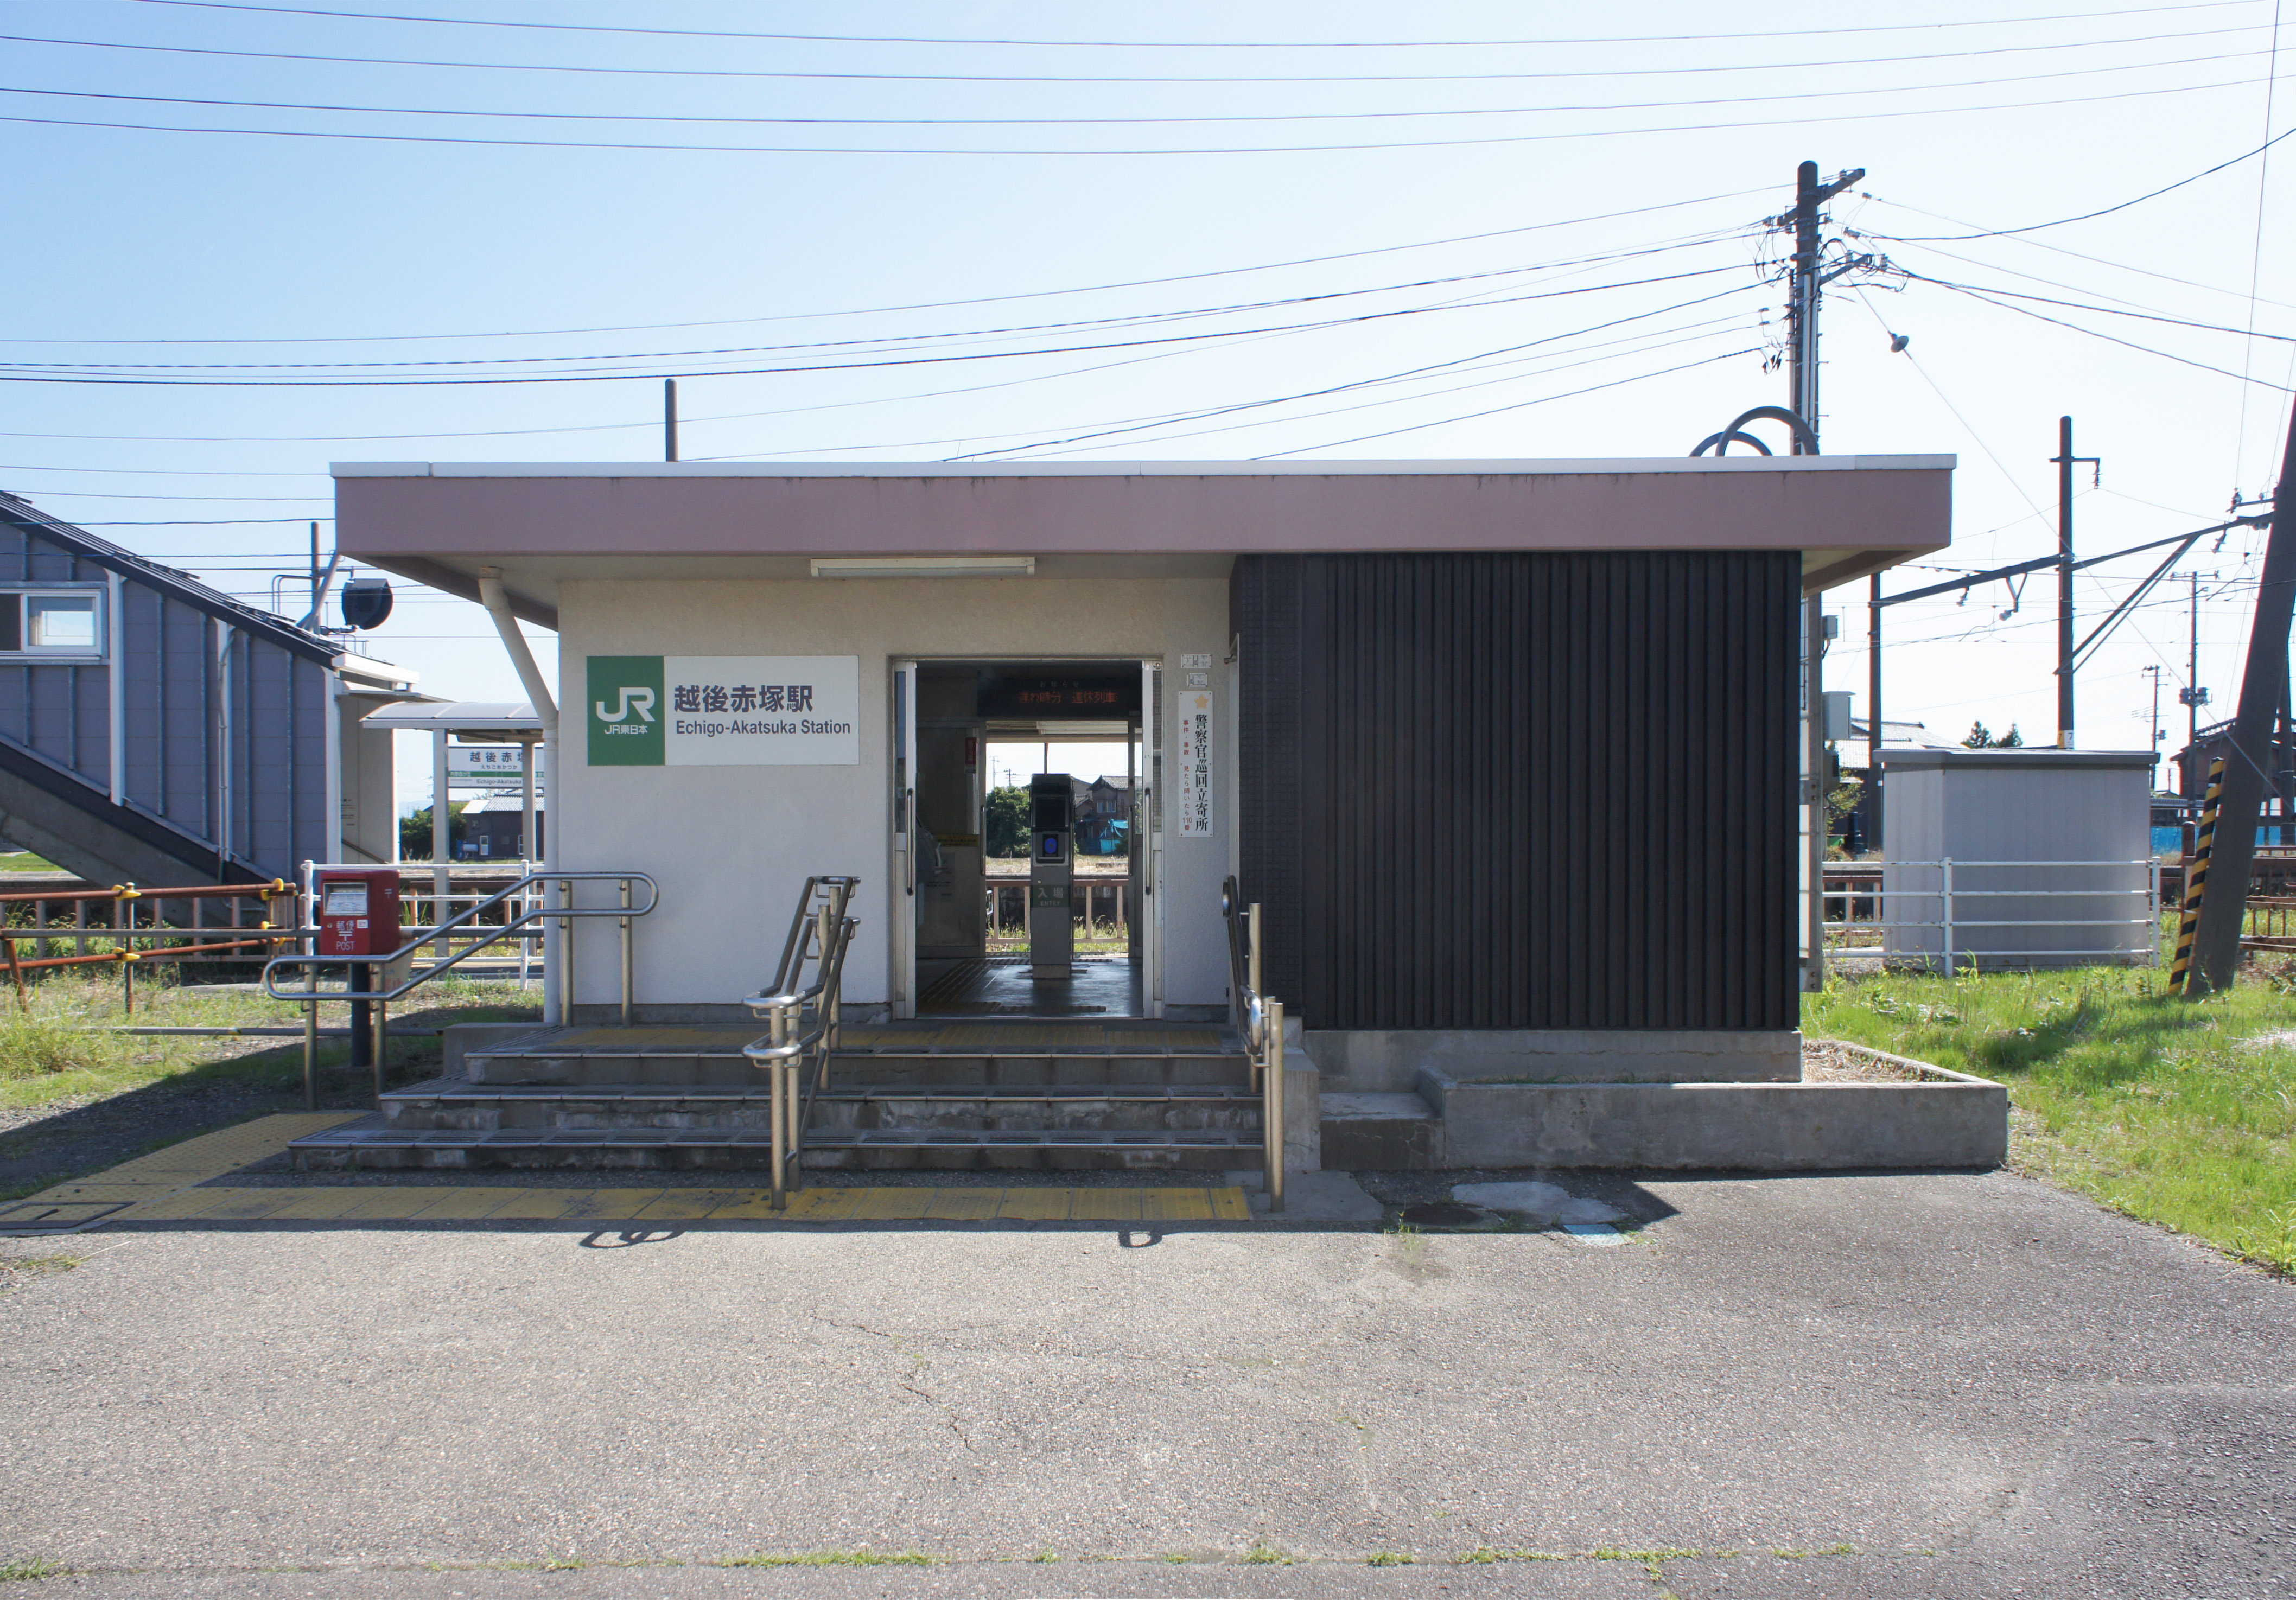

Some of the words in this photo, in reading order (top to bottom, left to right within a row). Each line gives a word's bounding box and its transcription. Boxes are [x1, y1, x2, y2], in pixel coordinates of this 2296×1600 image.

[596, 687, 656, 722] JR
[675, 685, 813, 713] 越後赤塚駅
[604, 724, 648, 735] JR東日本
[676, 719, 797, 737] Echigo-Akatsuka
[800, 719, 850, 734] Station
[1195, 714, 1208, 832] 警察官巡回立寄所
[1037, 887, 1064, 898] 入場
[336, 920, 354, 931] 郵便
[336, 941, 355, 951] POST
